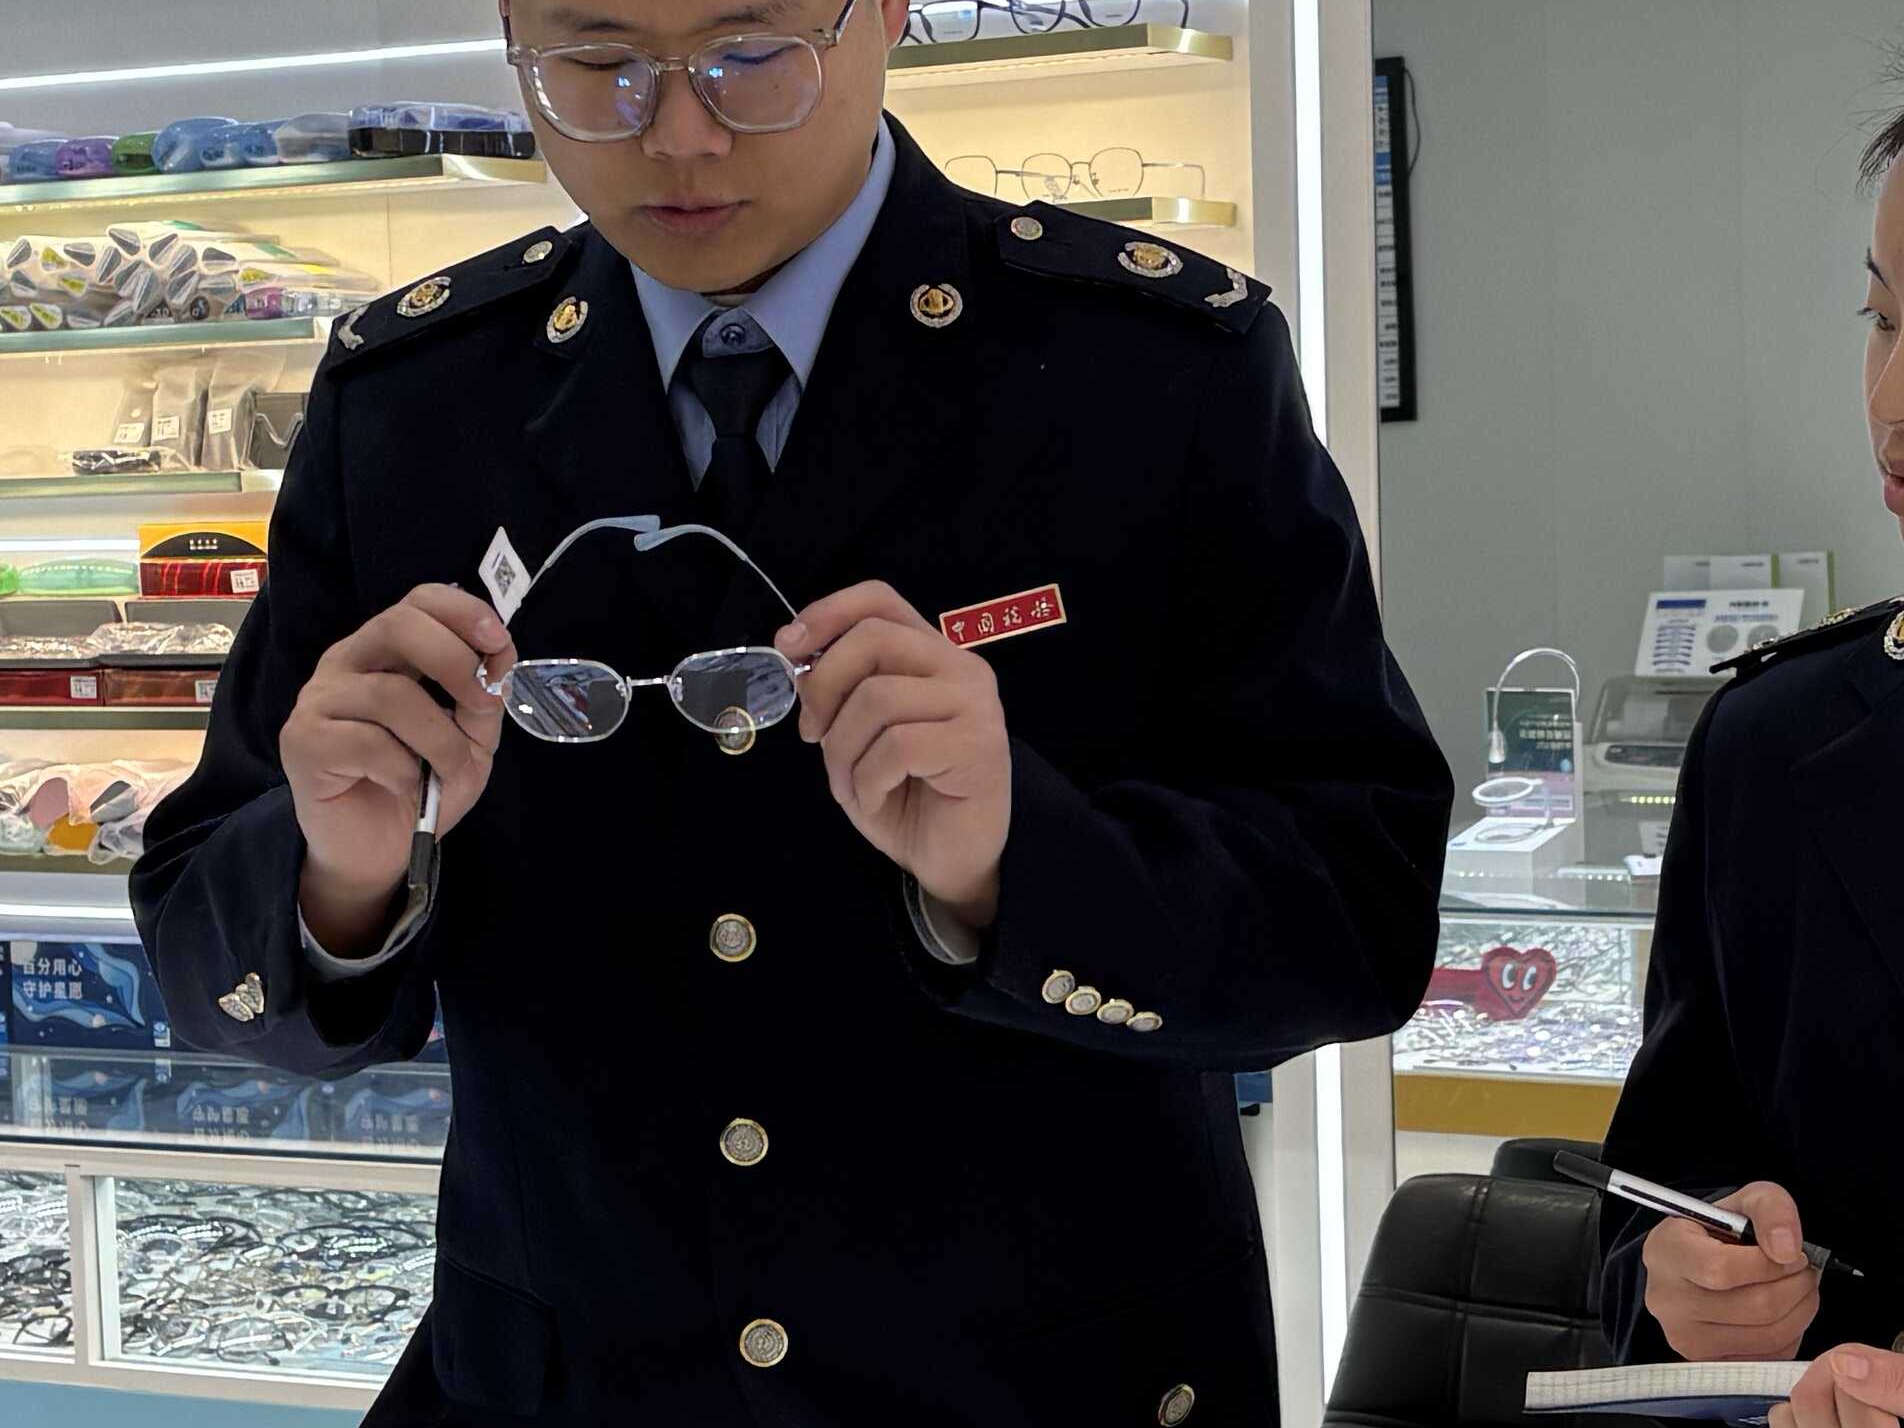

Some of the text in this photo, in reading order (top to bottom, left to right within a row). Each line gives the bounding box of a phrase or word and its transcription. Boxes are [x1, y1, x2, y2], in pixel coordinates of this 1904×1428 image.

[951, 596, 1054, 642] 中国税务
[22, 956, 83, 978] 百分用心
[22, 978, 84, 1001] 守护星愿
